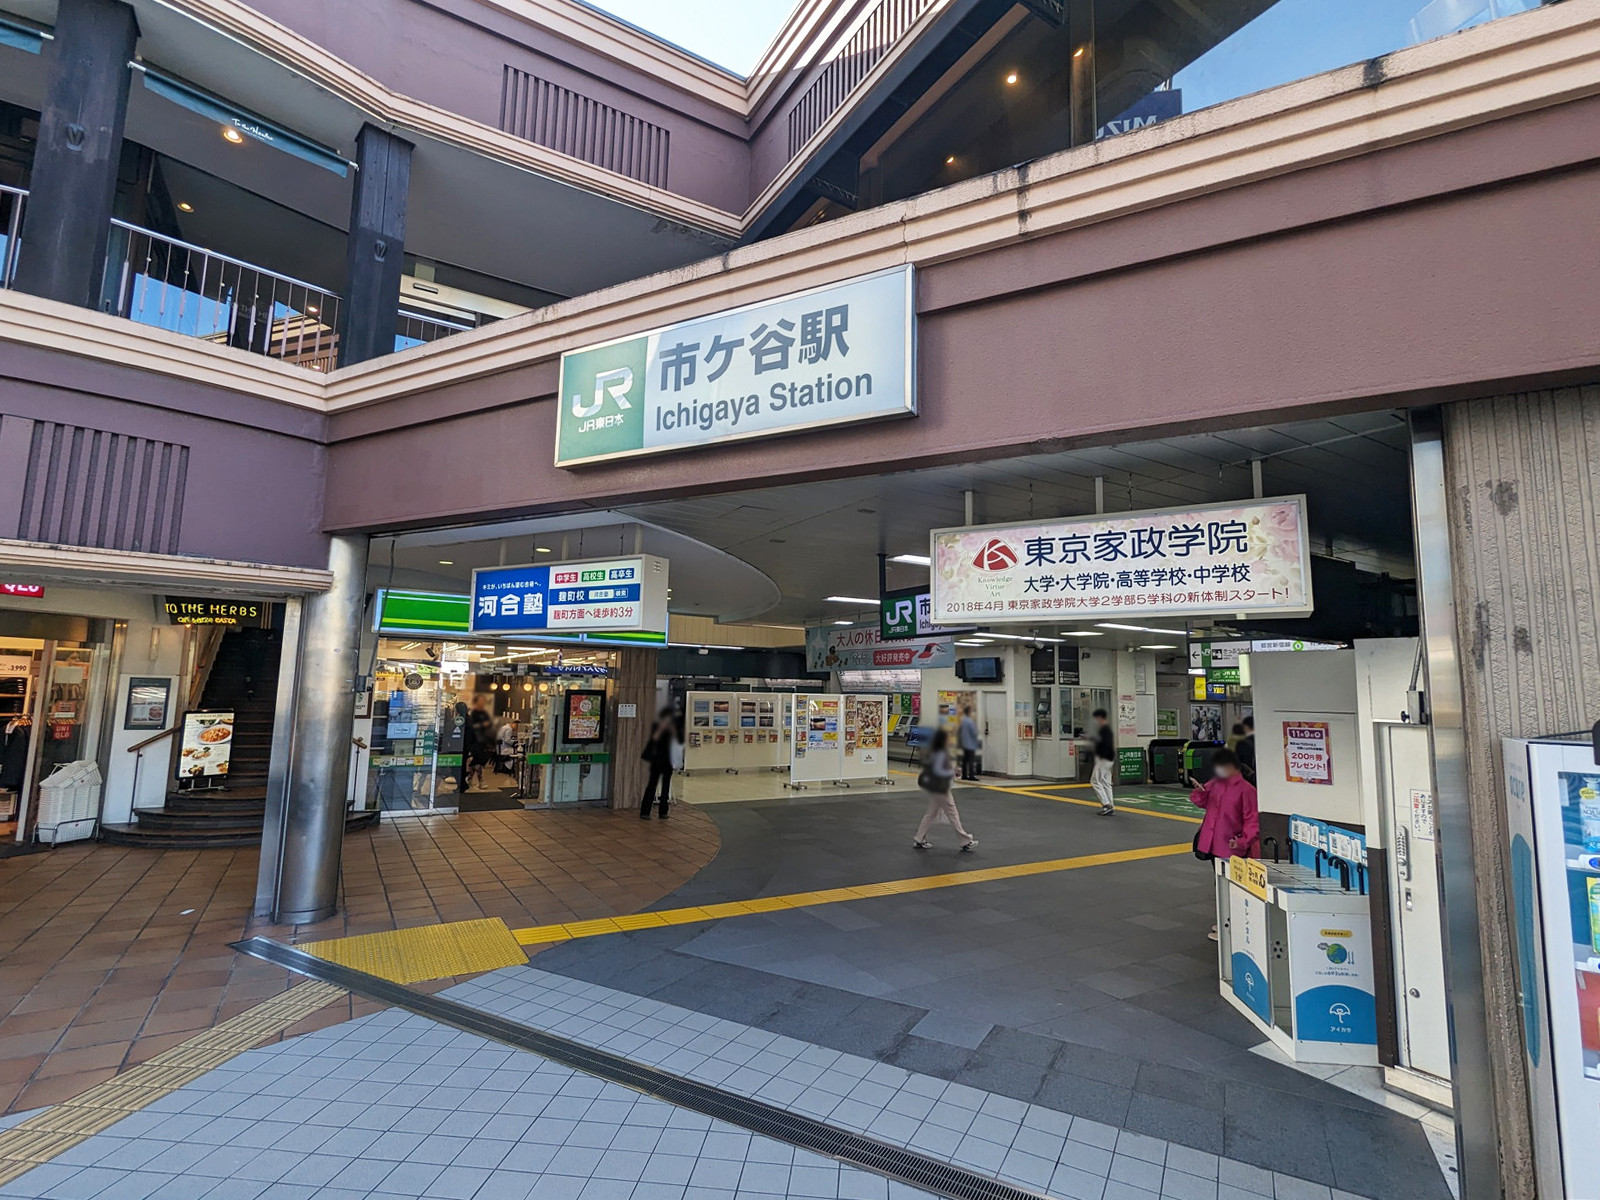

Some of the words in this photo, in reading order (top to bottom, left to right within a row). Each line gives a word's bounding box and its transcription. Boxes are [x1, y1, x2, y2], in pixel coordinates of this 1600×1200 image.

[658, 303, 851, 393] 市ケ谷駅
[572, 366, 634, 418] JR
[656, 394, 761, 431] Ichigaya
[769, 372, 873, 412] Station
[578, 413, 624, 432] JR東日本
[1023, 519, 1248, 567] 東京家政学院
[556, 572, 577, 583] 中学生
[583, 570, 604, 581] 高校生
[610, 568, 633, 580] 高卒生
[977, 575, 1014, 584] Knowledge
[1023, 562, 1251, 593] 大学・大学院・高等学校・中学校
[165, 603, 178, 614] TO
[181, 603, 205, 615] THE
[210, 604, 257, 618] HERBS
[477, 592, 543, 617] 河合塾
[886, 600, 913, 626] JR
[946, 600, 1004, 612] 2018年4月
[888, 625, 909, 634] JR東日本
[875, 652, 910, 663] 大好評発売中
